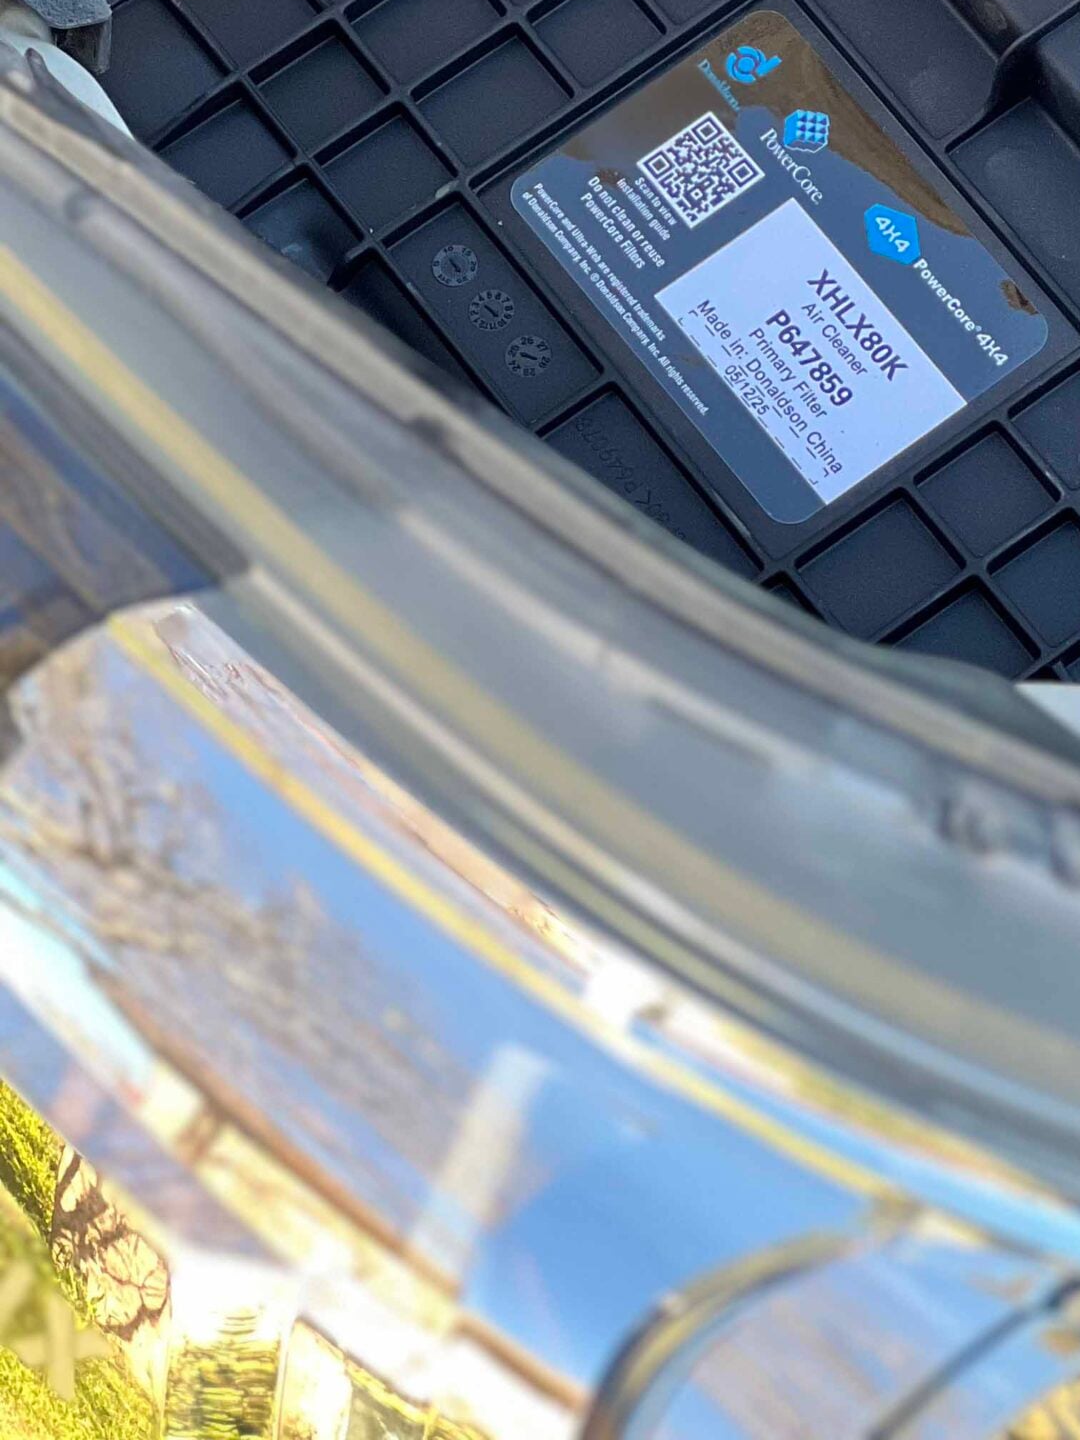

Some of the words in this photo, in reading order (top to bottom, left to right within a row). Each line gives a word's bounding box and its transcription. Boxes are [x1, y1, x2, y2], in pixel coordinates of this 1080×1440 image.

[522, 191, 534, 201] of
[527, 197, 558, 233] Donaldson
[634, 176, 655, 200] Scan
[650, 196, 662, 208] to
[658, 205, 677, 226] view
[580, 192, 624, 243] PowerCore
[619, 239, 646, 269] Filters
[587, 176, 603, 193] Do
[598, 190, 617, 208] not
[611, 205, 636, 232] clean
[631, 230, 645, 242] or
[639, 240, 665, 268] reuse
[648, 218, 671, 241] guide
[533, 182, 565, 219] PowerCore
[561, 217, 577, 231] and
[571, 227, 602, 264] Ultra-Web
[597, 261, 611, 275] are
[606, 272, 639, 307] registered
[632, 303, 666, 342] trademarks
[578, 259, 592, 275] Inc.
[595, 279, 626, 316] Donaldson
[800, 303, 825, 324] Air
[821, 324, 868, 375] Cleaner
[806, 268, 909, 382] XHLX80K
[647, 342, 661, 359] Inc.
[657, 355, 671, 368] All
[665, 365, 685, 386] rights
[748, 327, 797, 383] Primary
[792, 380, 828, 418] Filter
[765, 308, 854, 407] P647859
[680, 383, 710, 416] reserved.
[696, 299, 732, 340] Made
[728, 337, 749, 360] in:
[745, 357, 808, 433] Donaldson
[806, 431, 843, 474] China
[724, 364, 771, 416] 05/12/25
